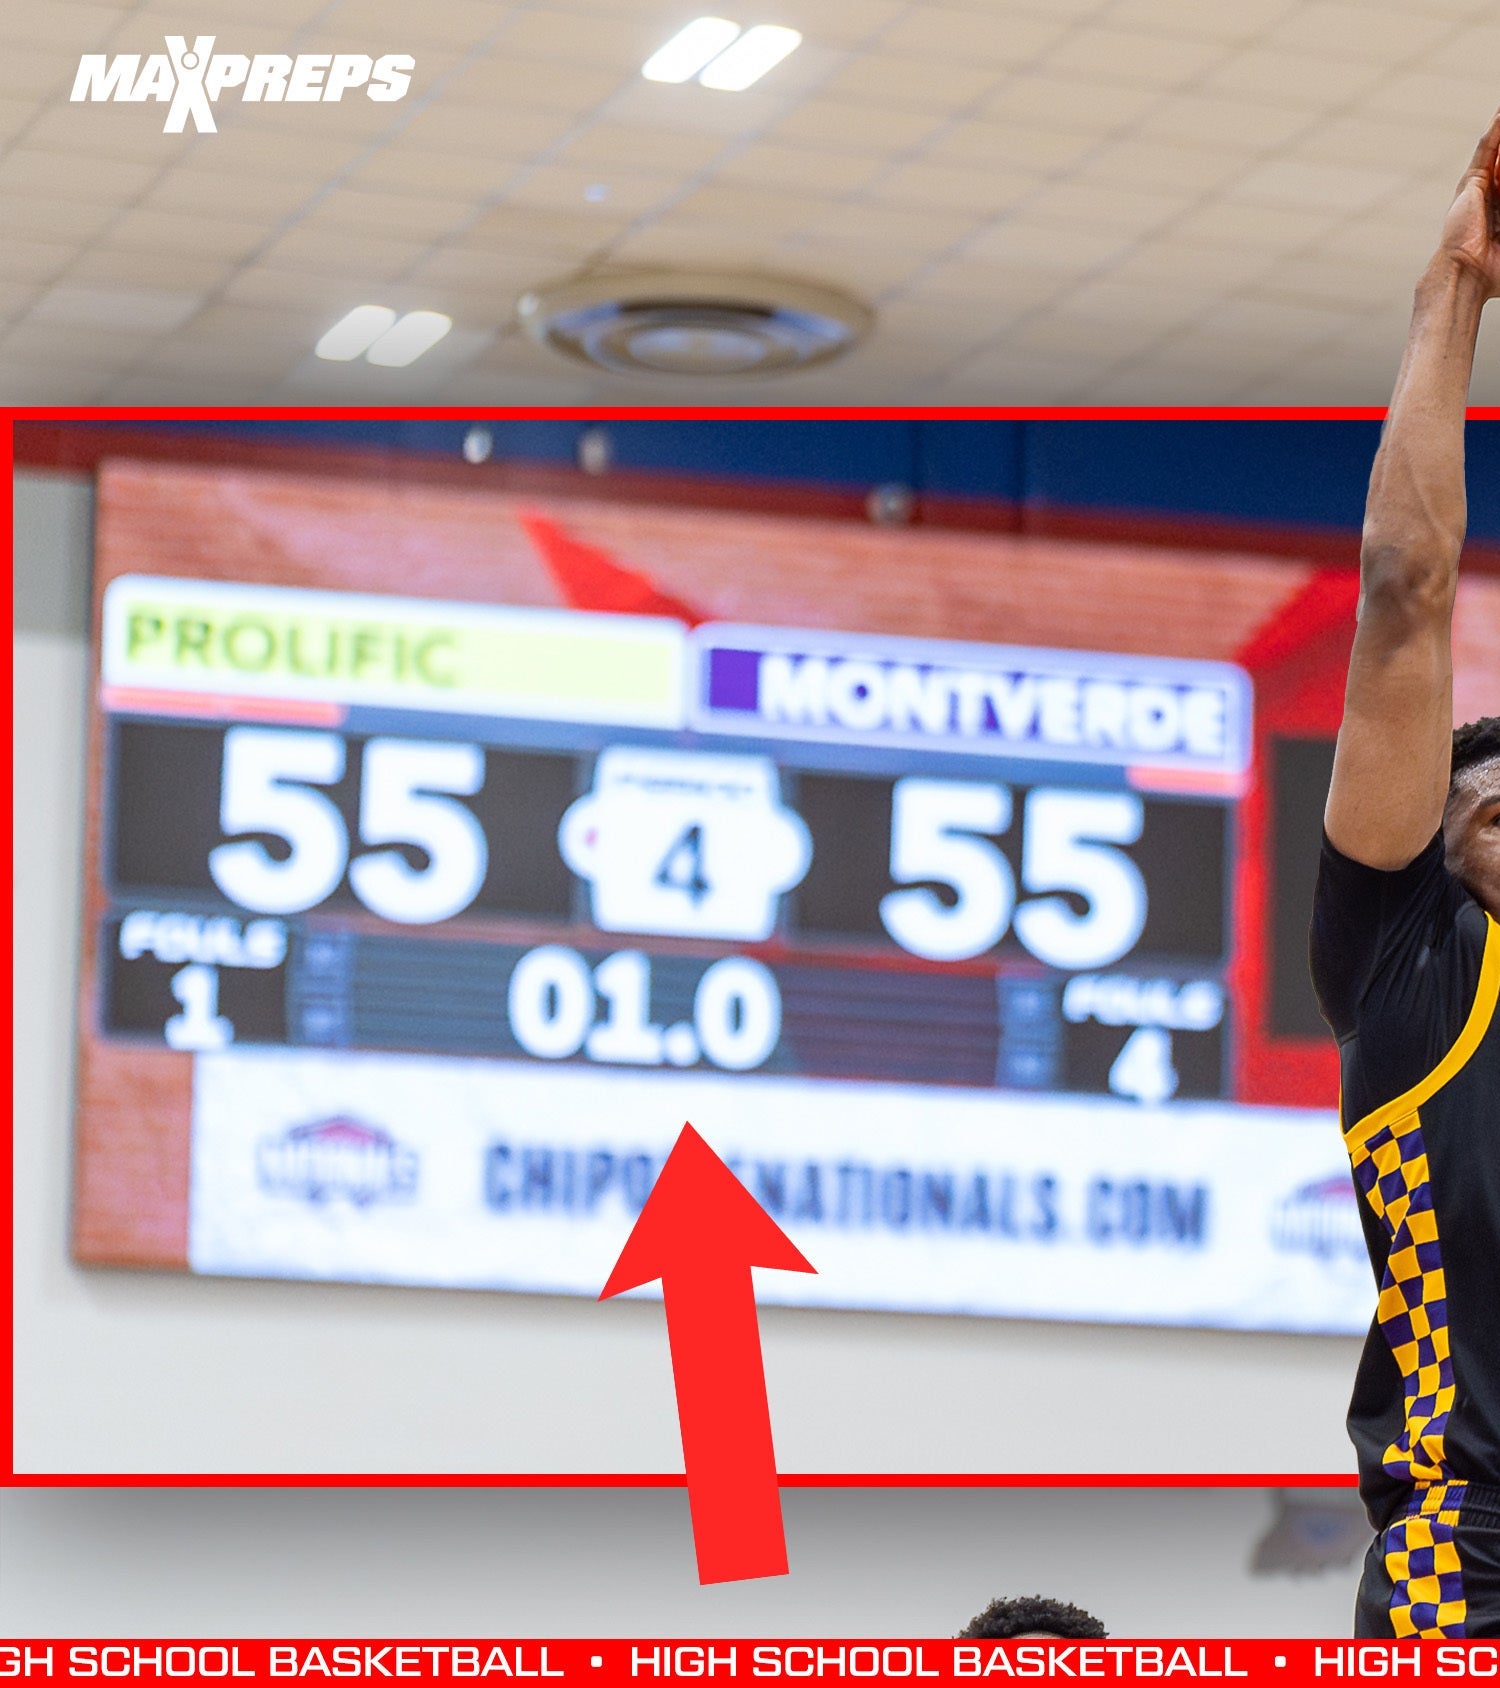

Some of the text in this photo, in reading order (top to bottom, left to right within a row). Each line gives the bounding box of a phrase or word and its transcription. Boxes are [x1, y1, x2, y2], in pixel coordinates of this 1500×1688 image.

[125, 609, 458, 686] PROLIFIC
[759, 653, 1226, 753] MONTVERDE
[208, 725, 489, 925] 55
[652, 820, 710, 906] 4
[878, 776, 1149, 971] 55
[164, 963, 235, 1050] 1
[508, 945, 783, 1072] 01.0
[1107, 1026, 1180, 1104] 4
